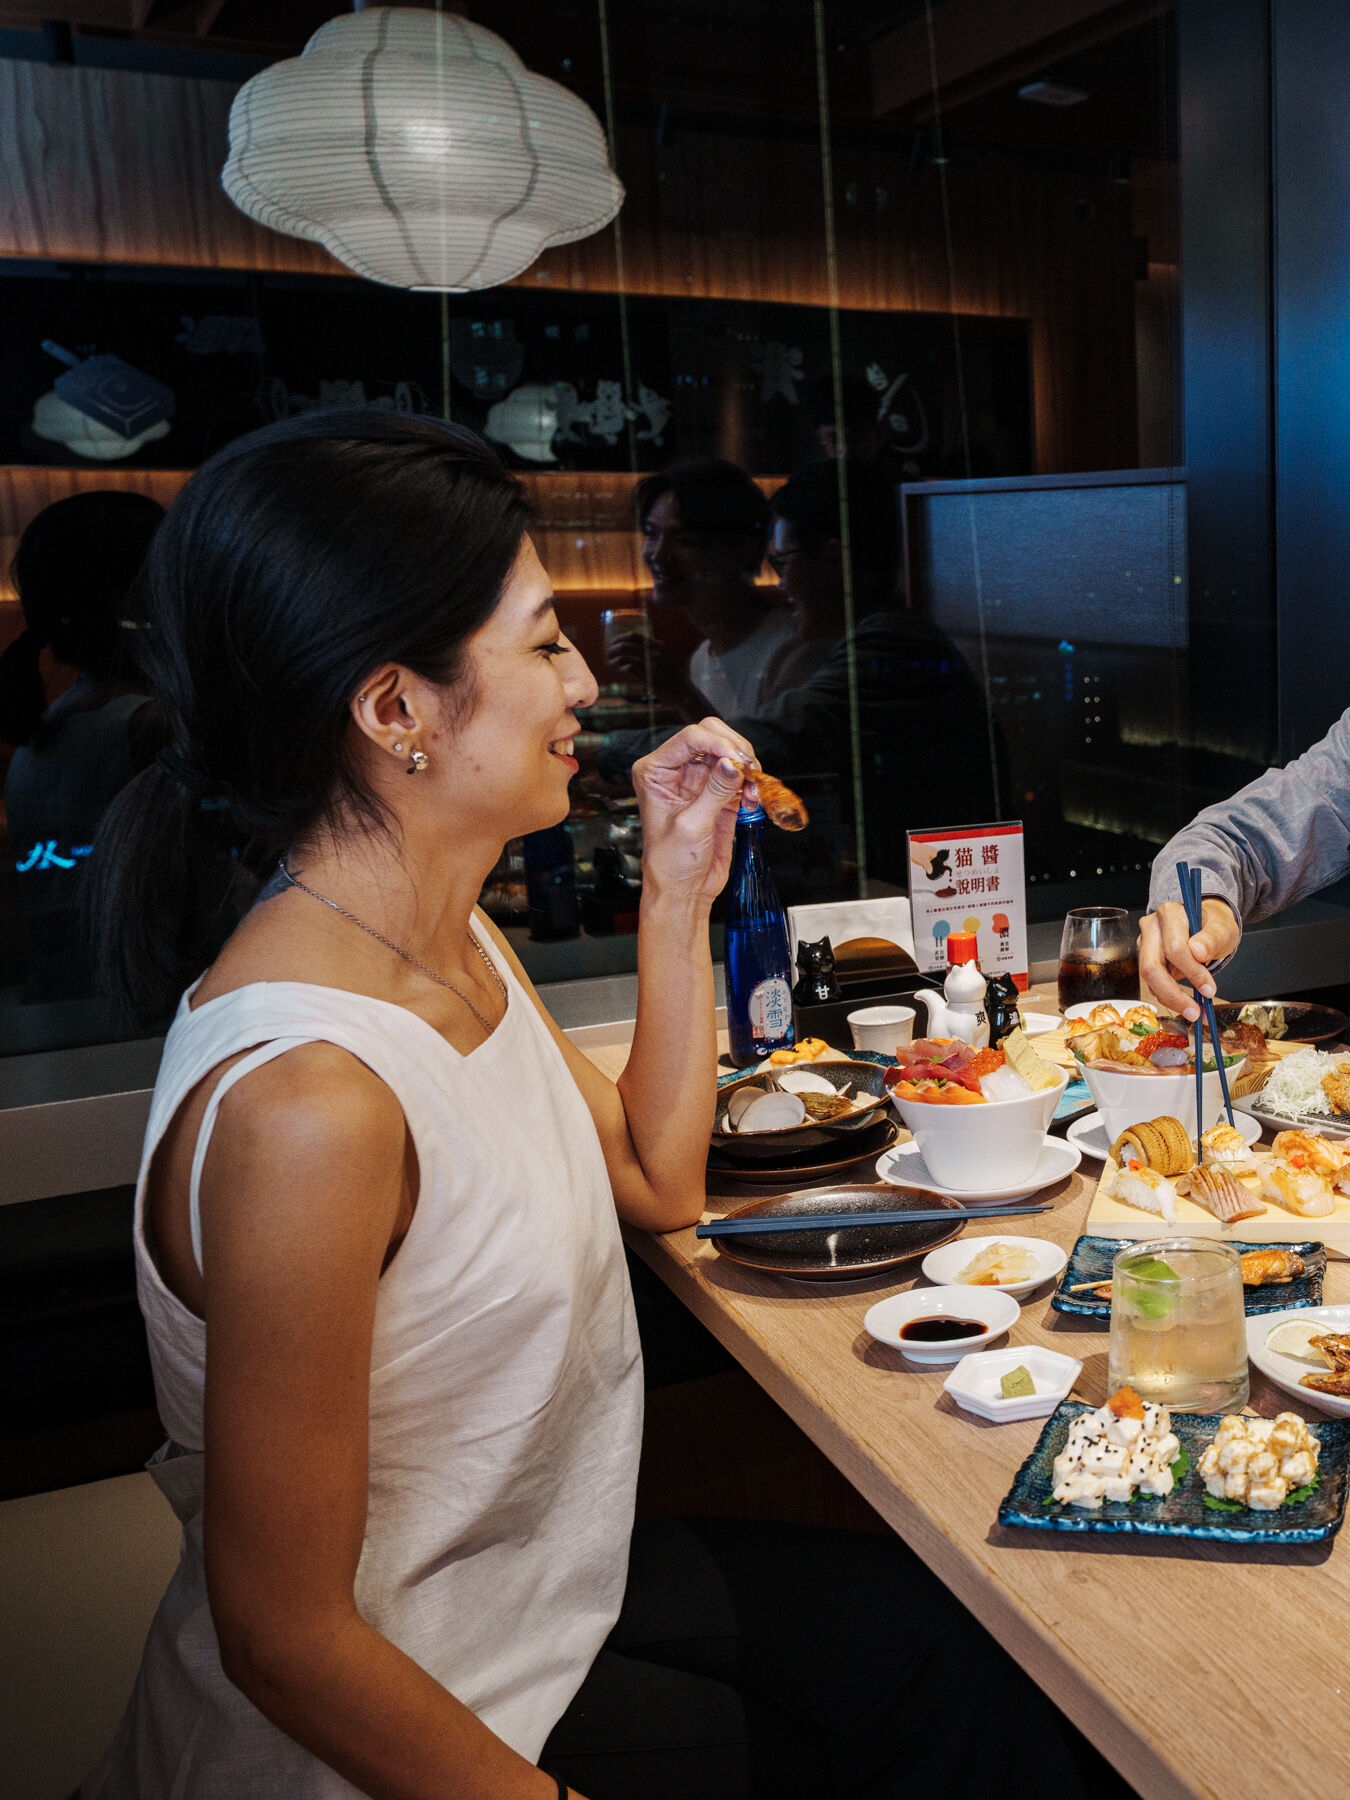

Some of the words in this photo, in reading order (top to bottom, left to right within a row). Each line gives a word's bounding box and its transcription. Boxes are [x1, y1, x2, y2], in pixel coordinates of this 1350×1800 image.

[955, 876, 1000, 895] 說明書
[815, 985, 830, 1001] 甘
[766, 988, 783, 1029] 淡雪
[974, 1010, 987, 1027] 爽
